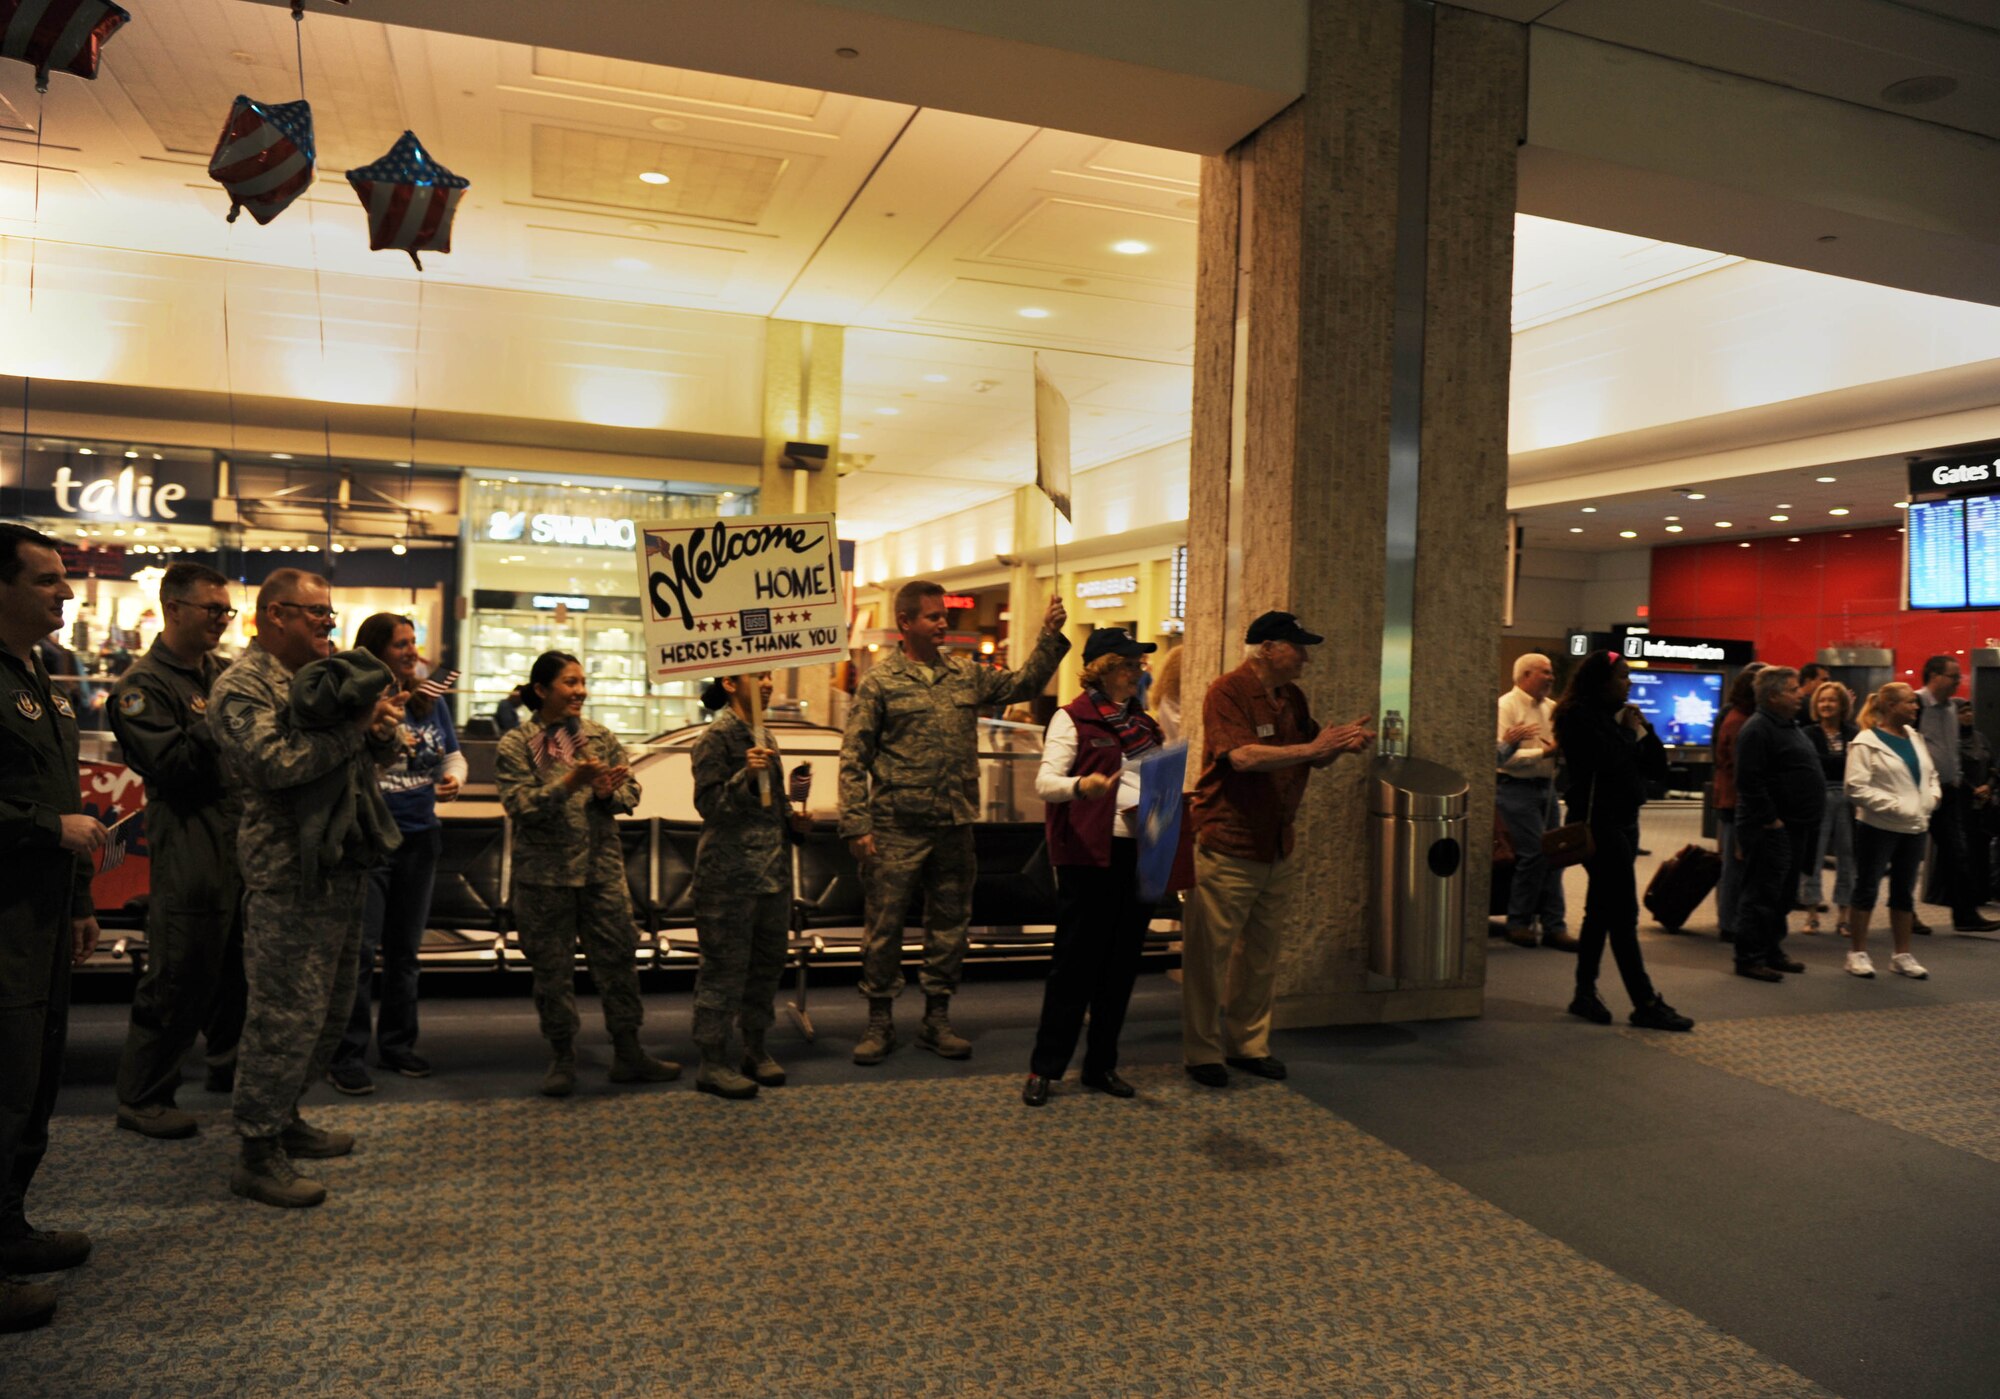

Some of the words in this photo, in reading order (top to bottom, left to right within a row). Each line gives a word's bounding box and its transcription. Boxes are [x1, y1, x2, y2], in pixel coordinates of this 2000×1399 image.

[1932, 464, 1989, 485] Gates
[51, 465, 186, 519] talie
[531, 514, 637, 547] SWARO
[649, 521, 824, 630] Welcome
[754, 552, 836, 600] HOME!
[809, 628, 837, 646] YOU
[1643, 640, 1725, 660] Information
